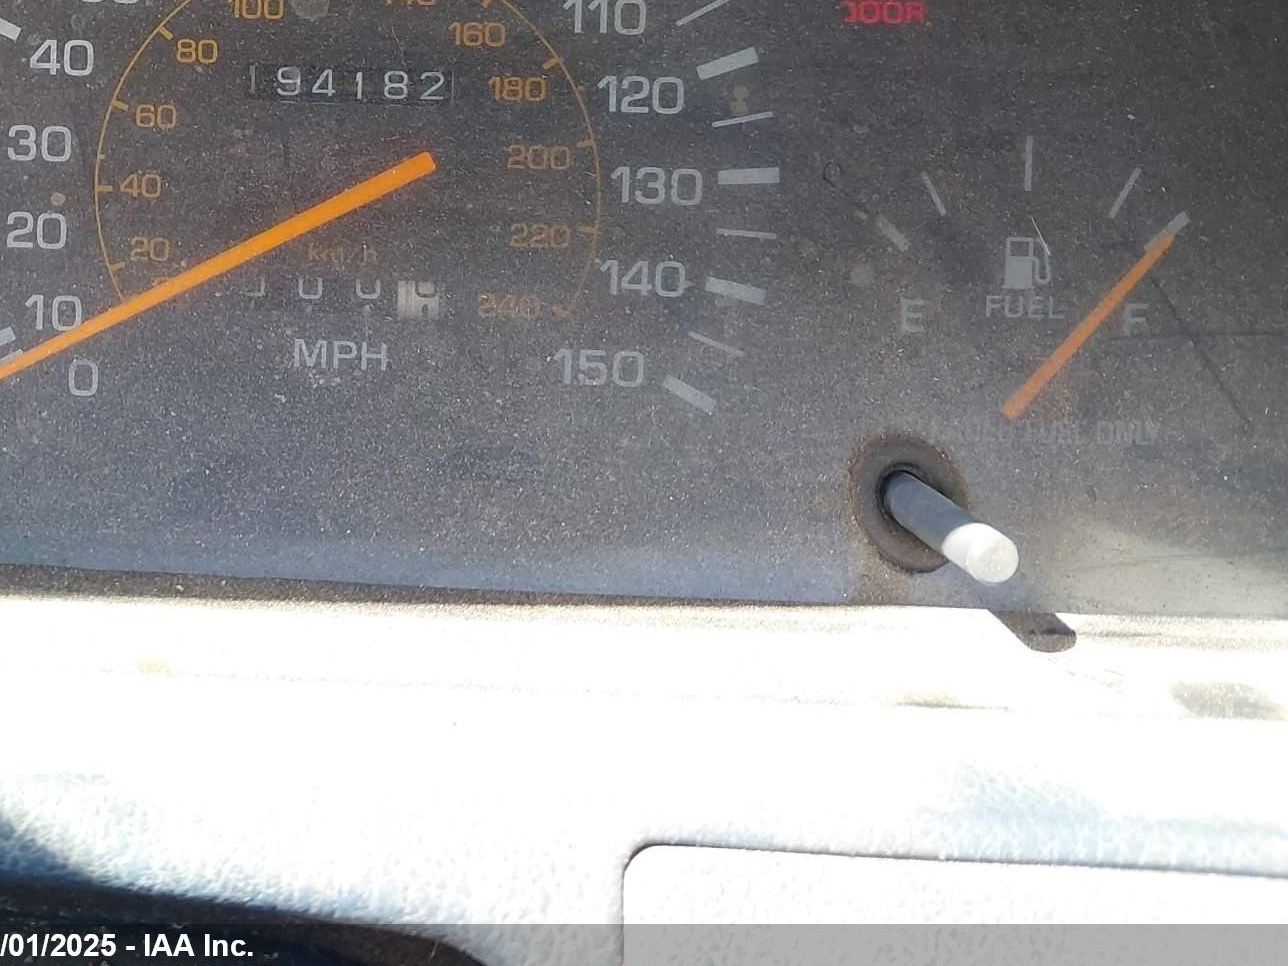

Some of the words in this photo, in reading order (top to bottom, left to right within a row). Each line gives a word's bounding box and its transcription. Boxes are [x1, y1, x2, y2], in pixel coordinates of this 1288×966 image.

[449, 22, 506, 47] 160
[30, 39, 94, 76] 40
[176, 39, 218, 64] 80
[488, 76, 546, 102] 180
[597, 76, 684, 114] 120
[136, 104, 177, 129] 60
[8, 125, 72, 162] 30
[506, 144, 571, 171] 200
[120, 174, 162, 198] 40
[611, 166, 703, 206] 130
[7, 211, 68, 249] 20
[511, 224, 571, 249] 220
[130, 237, 170, 262] 20
[600, 260, 687, 298] 140
[25, 295, 83, 332] 10
[477, 292, 541, 318] 240
[901, 298, 926, 334] E
[985, 295, 1064, 319] FUEL
[1123, 304, 1149, 334] F
[294, 338, 388, 371] MPH
[553, 349, 645, 388] 150
[68, 360, 99, 396] 0
